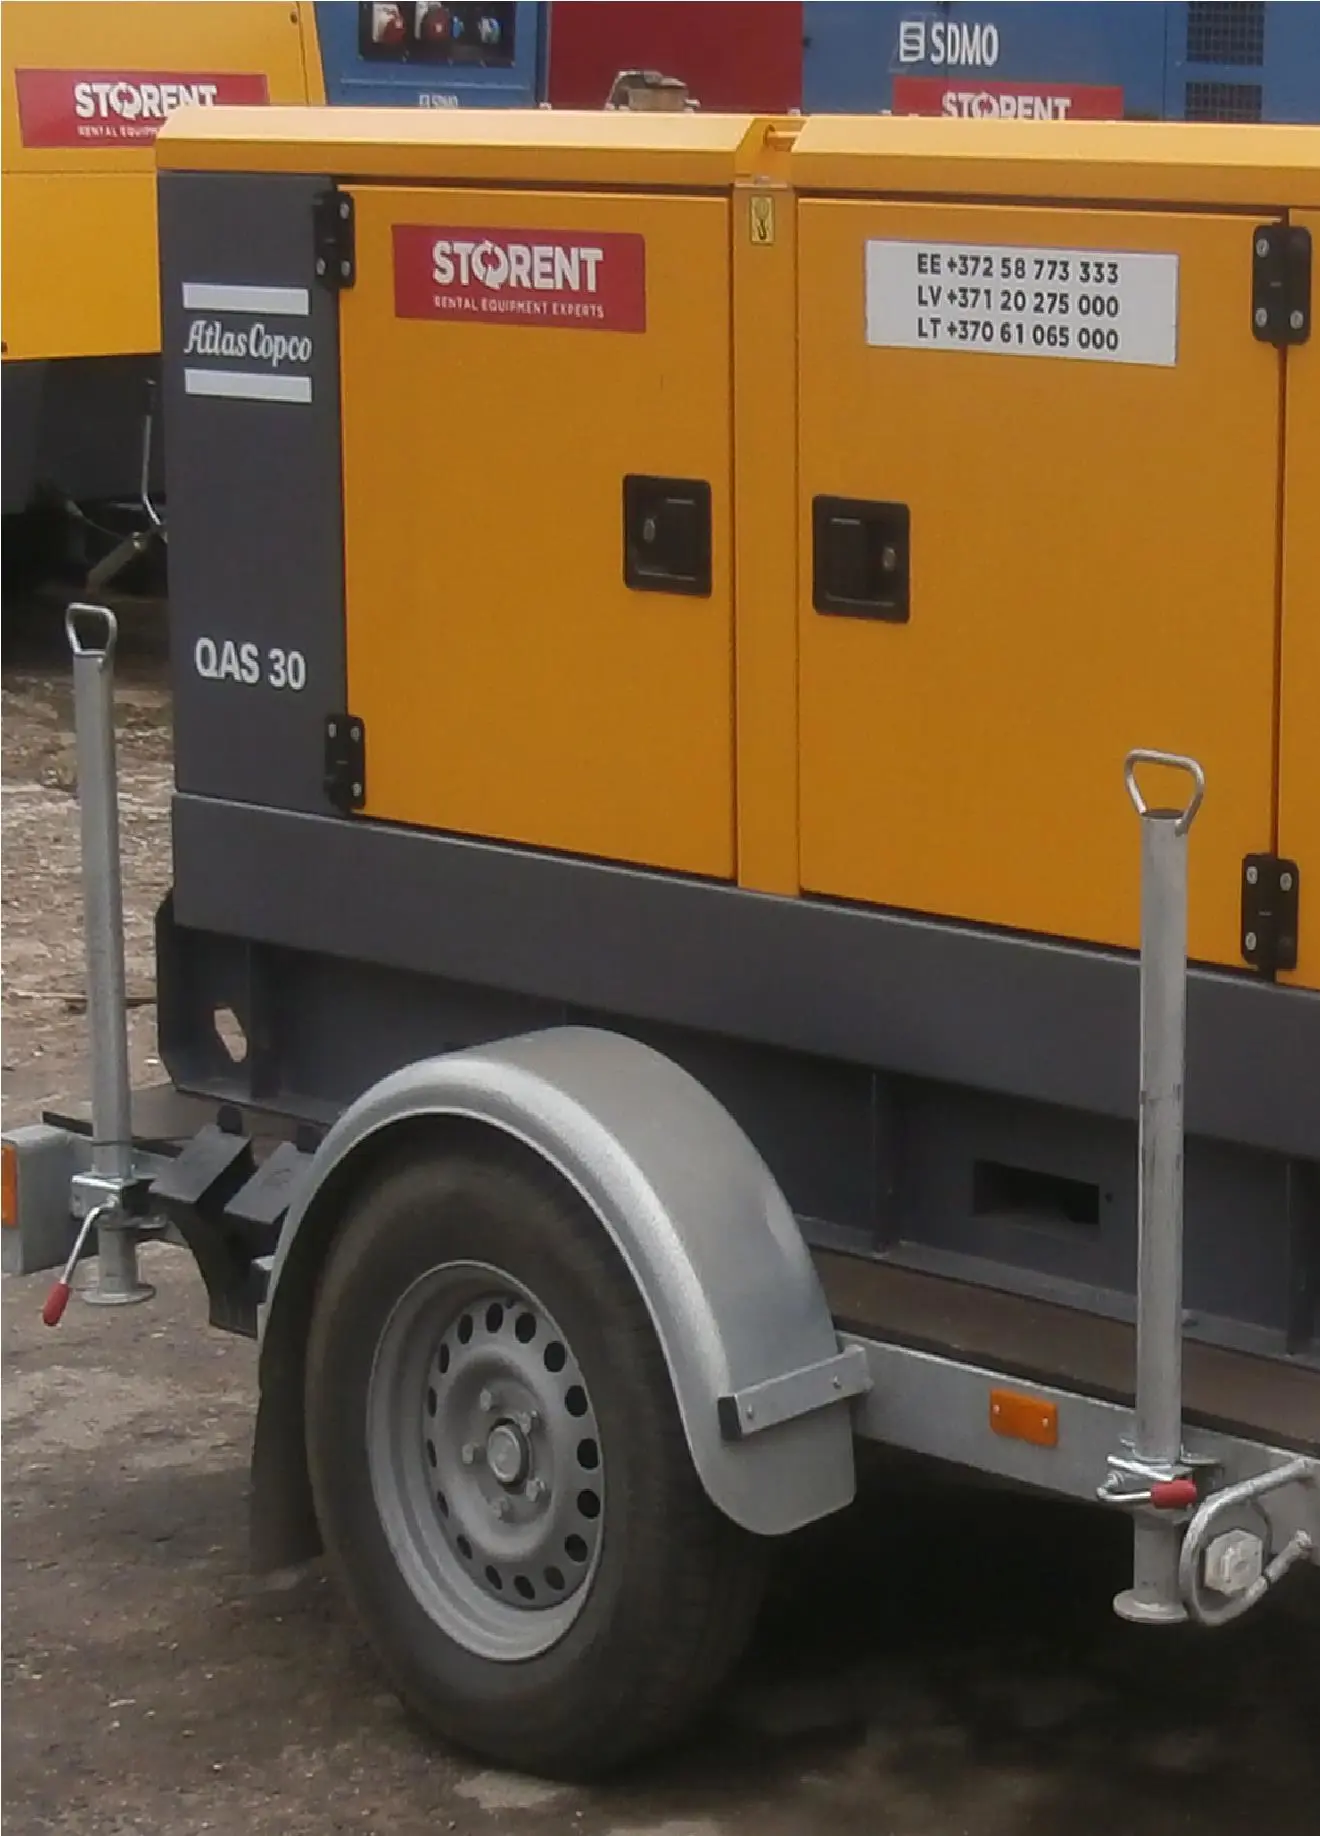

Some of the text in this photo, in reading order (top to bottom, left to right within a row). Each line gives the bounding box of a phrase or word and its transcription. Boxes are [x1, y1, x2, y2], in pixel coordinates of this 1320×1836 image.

[930, 22, 999, 67] SDMO
[74, 82, 217, 120] STORENT
[942, 91, 1072, 120] STORENT
[432, 239, 604, 293] STORENT
[917, 253, 1119, 284] EE +372 58 773 333
[433, 295, 605, 319] RENTAL EQUIPMENT EXPERTS
[917, 285, 1119, 317] LV +371 20 275 000
[917, 317, 1119, 350] LT +370 61 065 000
[195, 637, 307, 690] QAS 30
